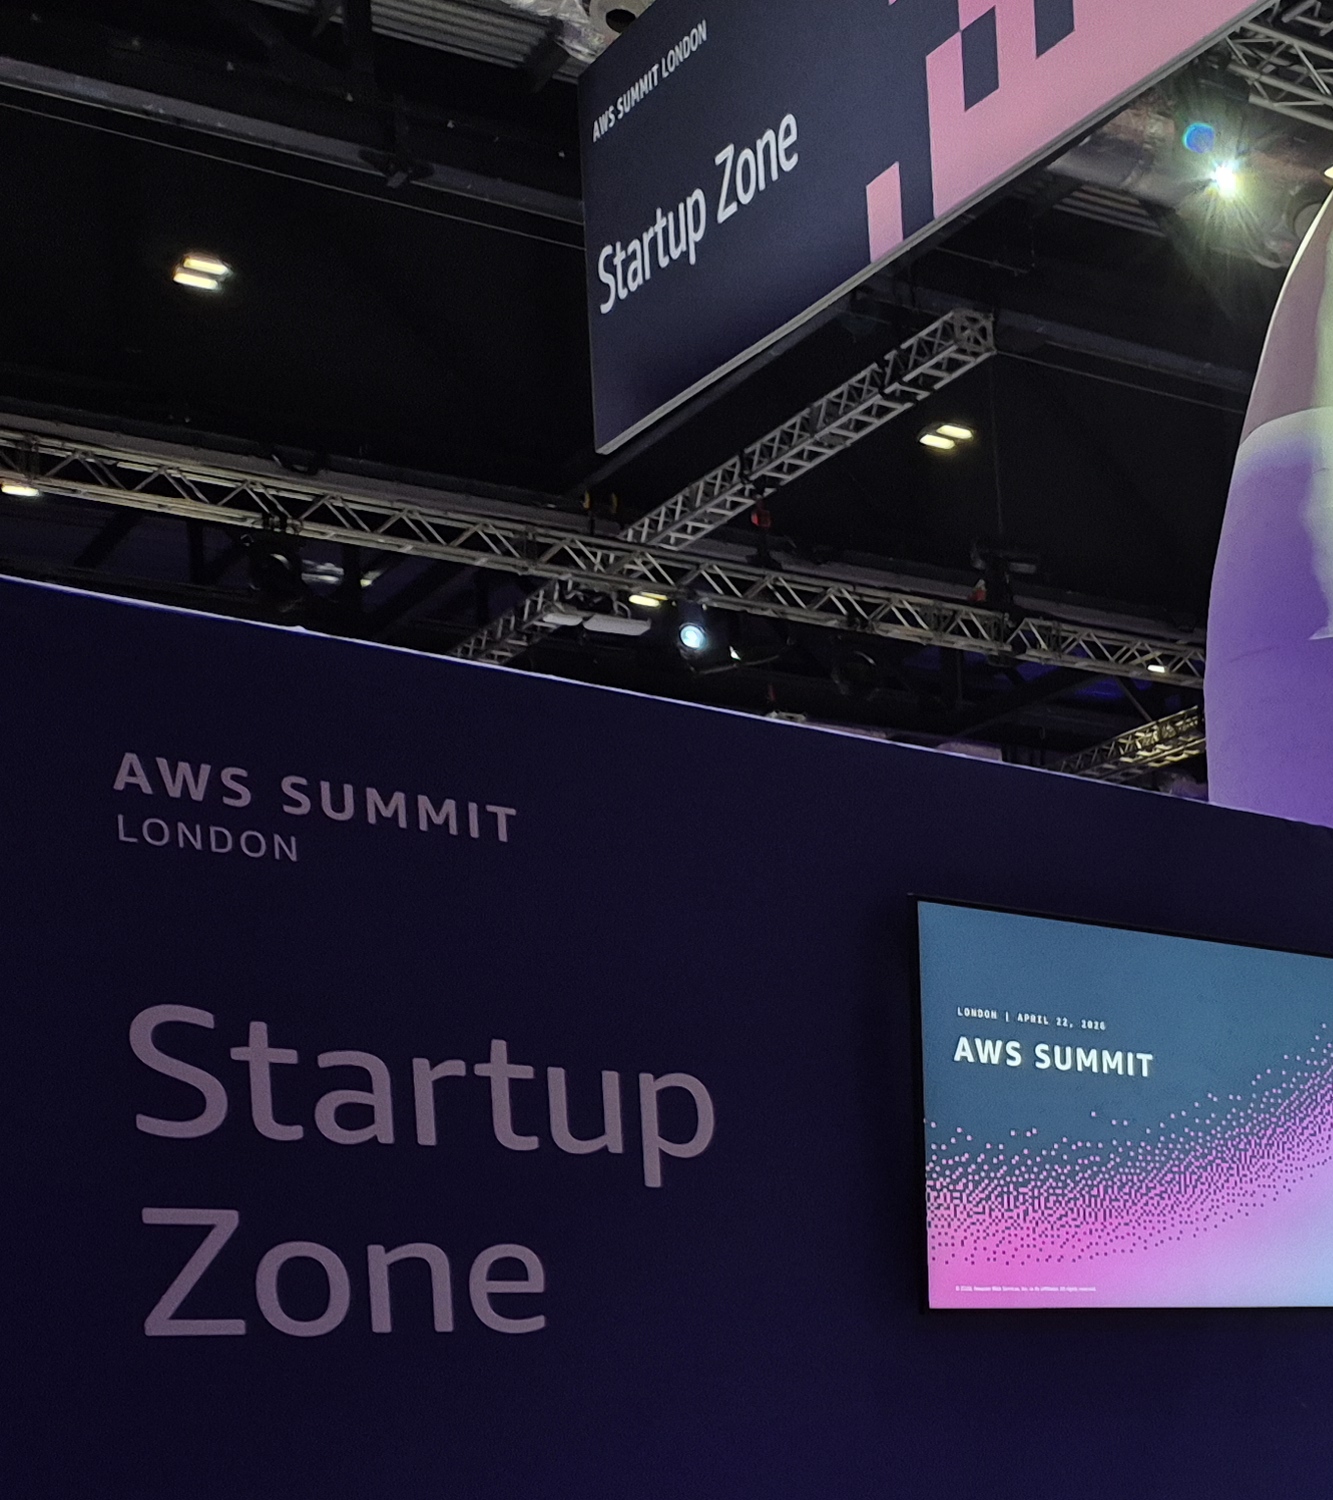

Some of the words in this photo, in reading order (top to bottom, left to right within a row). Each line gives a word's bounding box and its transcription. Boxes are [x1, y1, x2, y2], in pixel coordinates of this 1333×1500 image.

[592, 105, 615, 143] AWS
[616, 63, 659, 120] SUMMIT
[661, 19, 707, 78] LONDON
[597, 185, 705, 315] Startup
[714, 112, 799, 225] Zone
[113, 752, 253, 808] AWS
[280, 775, 517, 843] SUMMIT
[115, 812, 299, 863] LONDON
[953, 1036, 1022, 1067] AWS
[1034, 1043, 1154, 1078] SUMMIT
[957, 1006, 998, 1020] LONDON
[1017, 1013, 1049, 1026] APRIL
[1056, 1016, 1074, 1029] 22,
[127, 1003, 715, 1188] Startup
[141, 1207, 546, 1338] Zone
